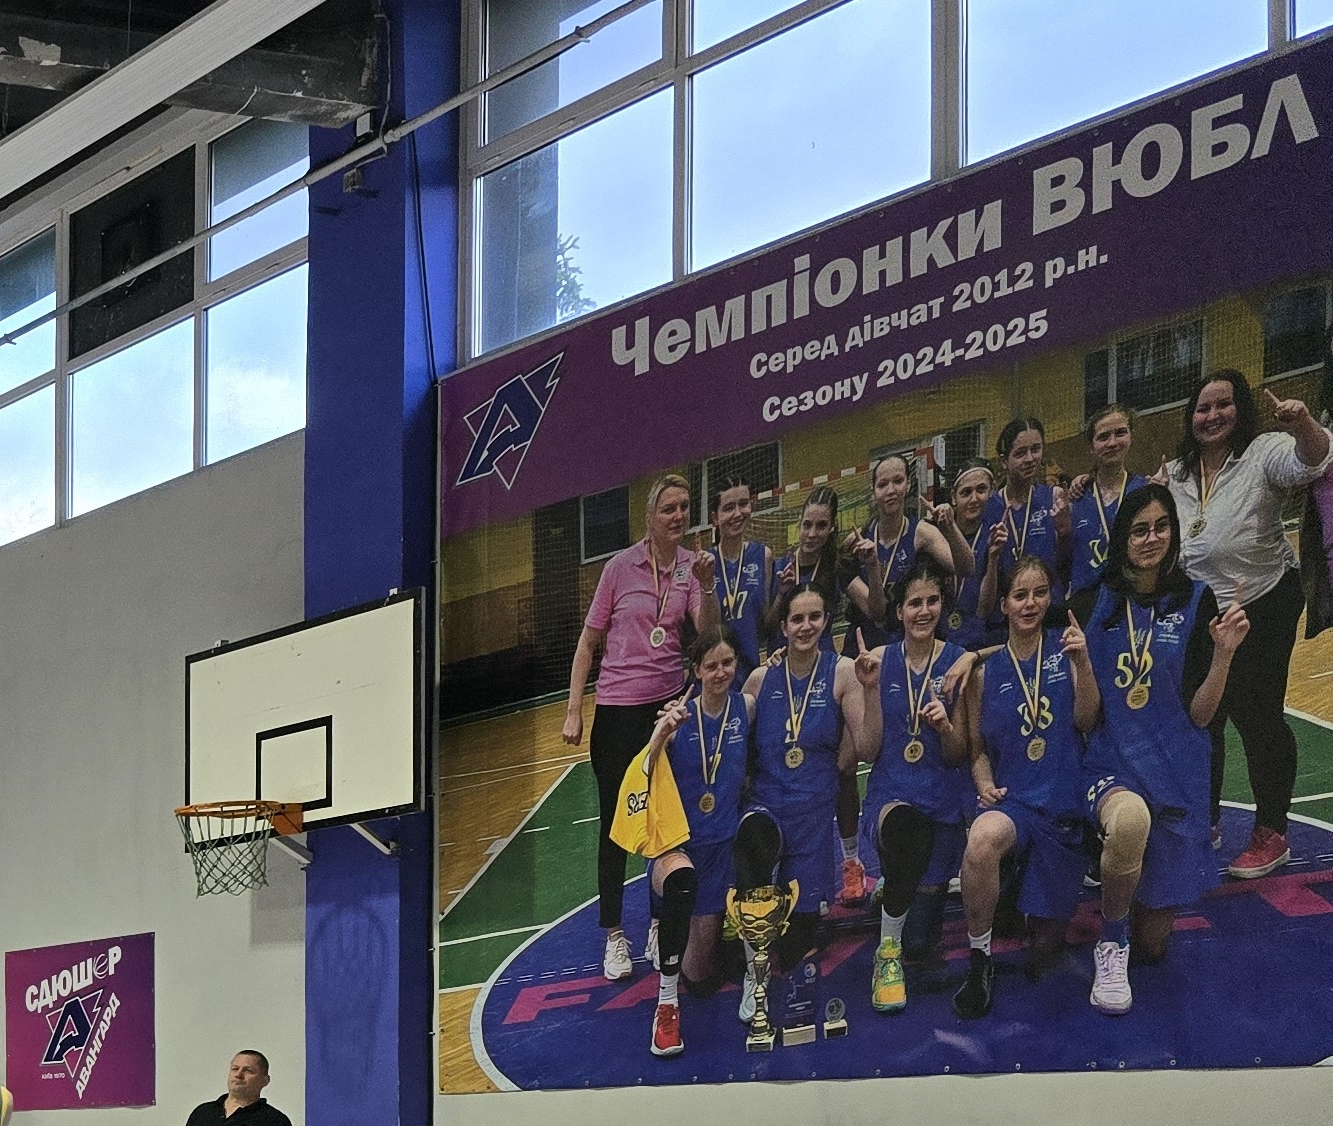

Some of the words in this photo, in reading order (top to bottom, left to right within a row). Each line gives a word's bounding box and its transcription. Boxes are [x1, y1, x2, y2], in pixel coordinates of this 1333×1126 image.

[612, 200, 1002, 377] Чемпіонки
[1033, 73, 1319, 235] ВЮБЛ
[751, 331, 840, 380] Серед
[845, 296, 946, 353] дівчат
[953, 262, 1035, 313] 2012
[1044, 246, 1108, 289] р.н.
[762, 370, 869, 422] Сезону
[877, 309, 1050, 387] 2024-2025
[76, 993, 121, 1099] АВАНГАРД
